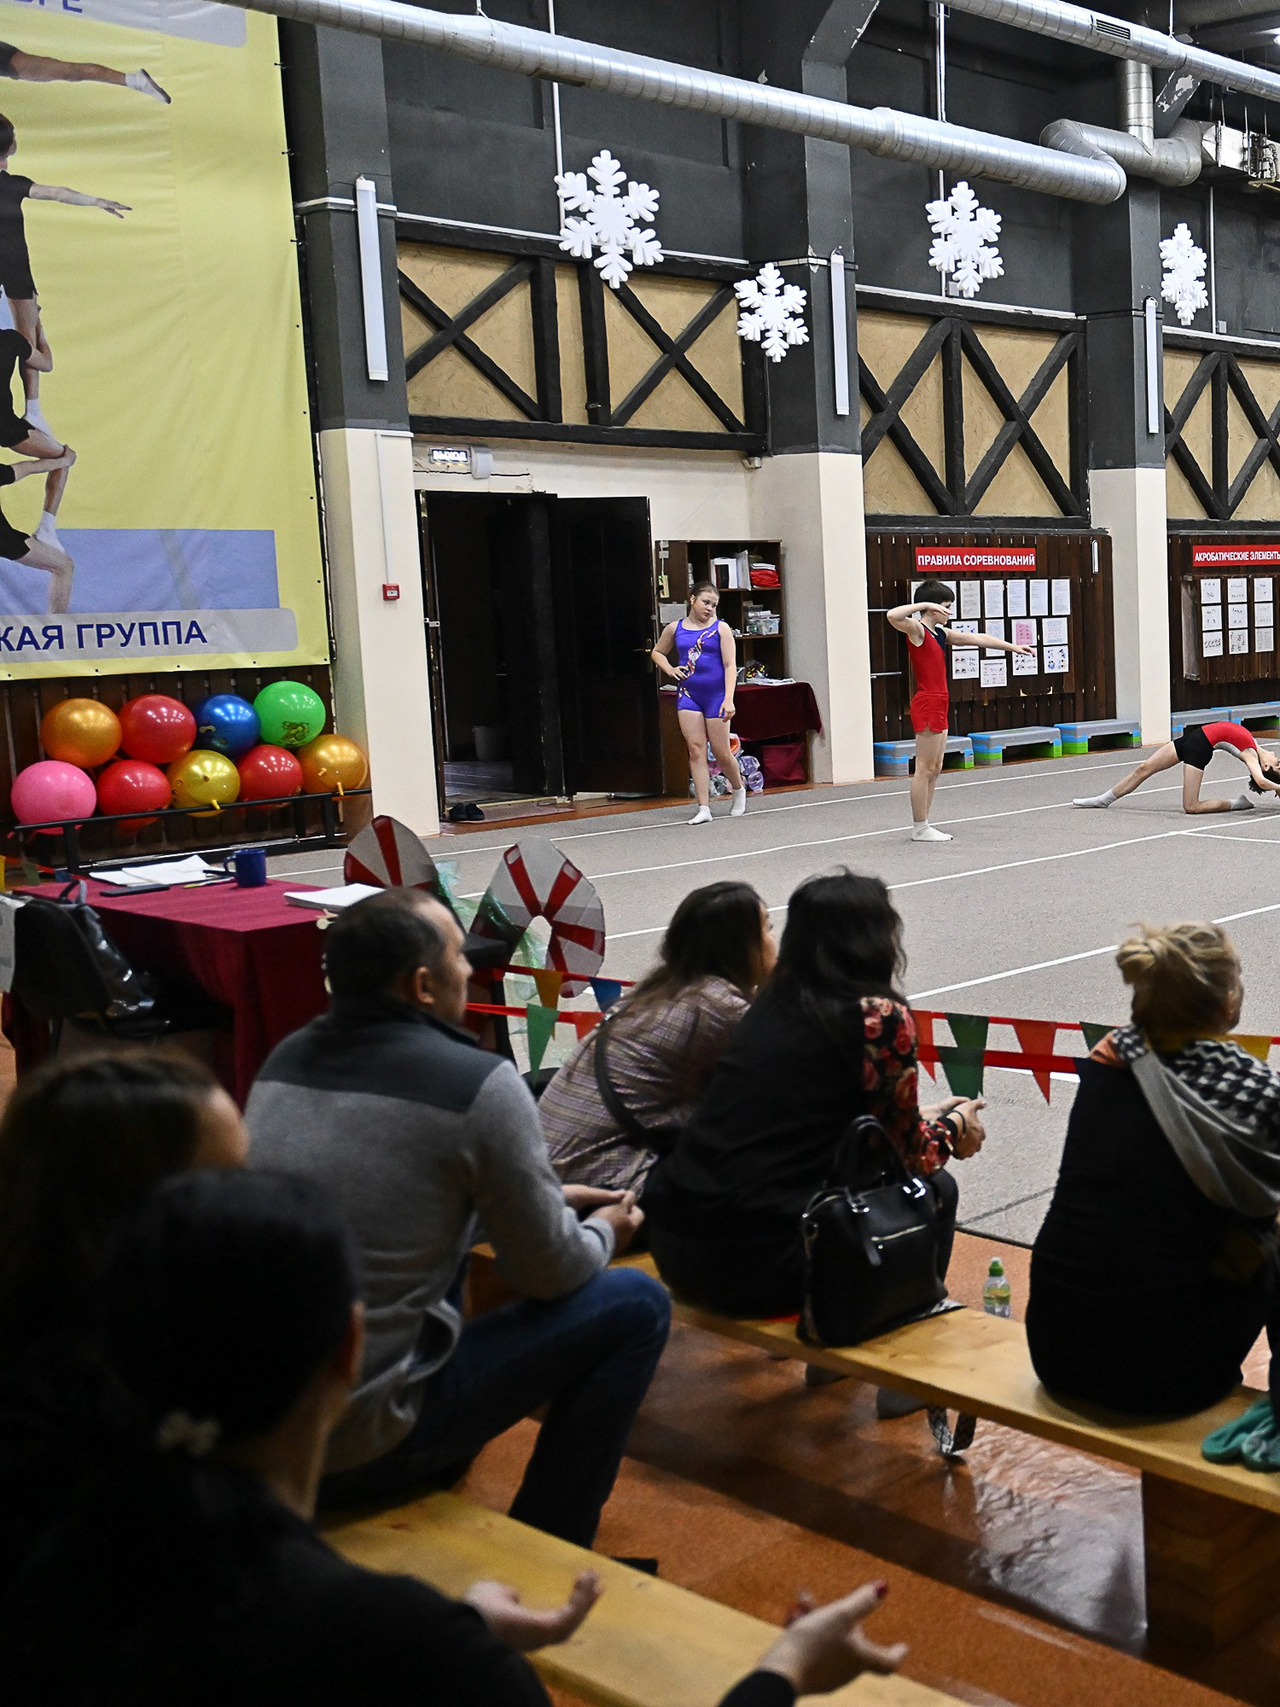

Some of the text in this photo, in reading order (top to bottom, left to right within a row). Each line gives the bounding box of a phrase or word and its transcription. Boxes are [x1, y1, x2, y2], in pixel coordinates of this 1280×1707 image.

[917, 553, 1035, 566] ПРАВИЛА СОРЕВНОВАНИЙ
[1194, 551, 1249, 562] АКРОБАТИЧЕСКИЕ
[76, 620, 208, 649] ГРУППА
